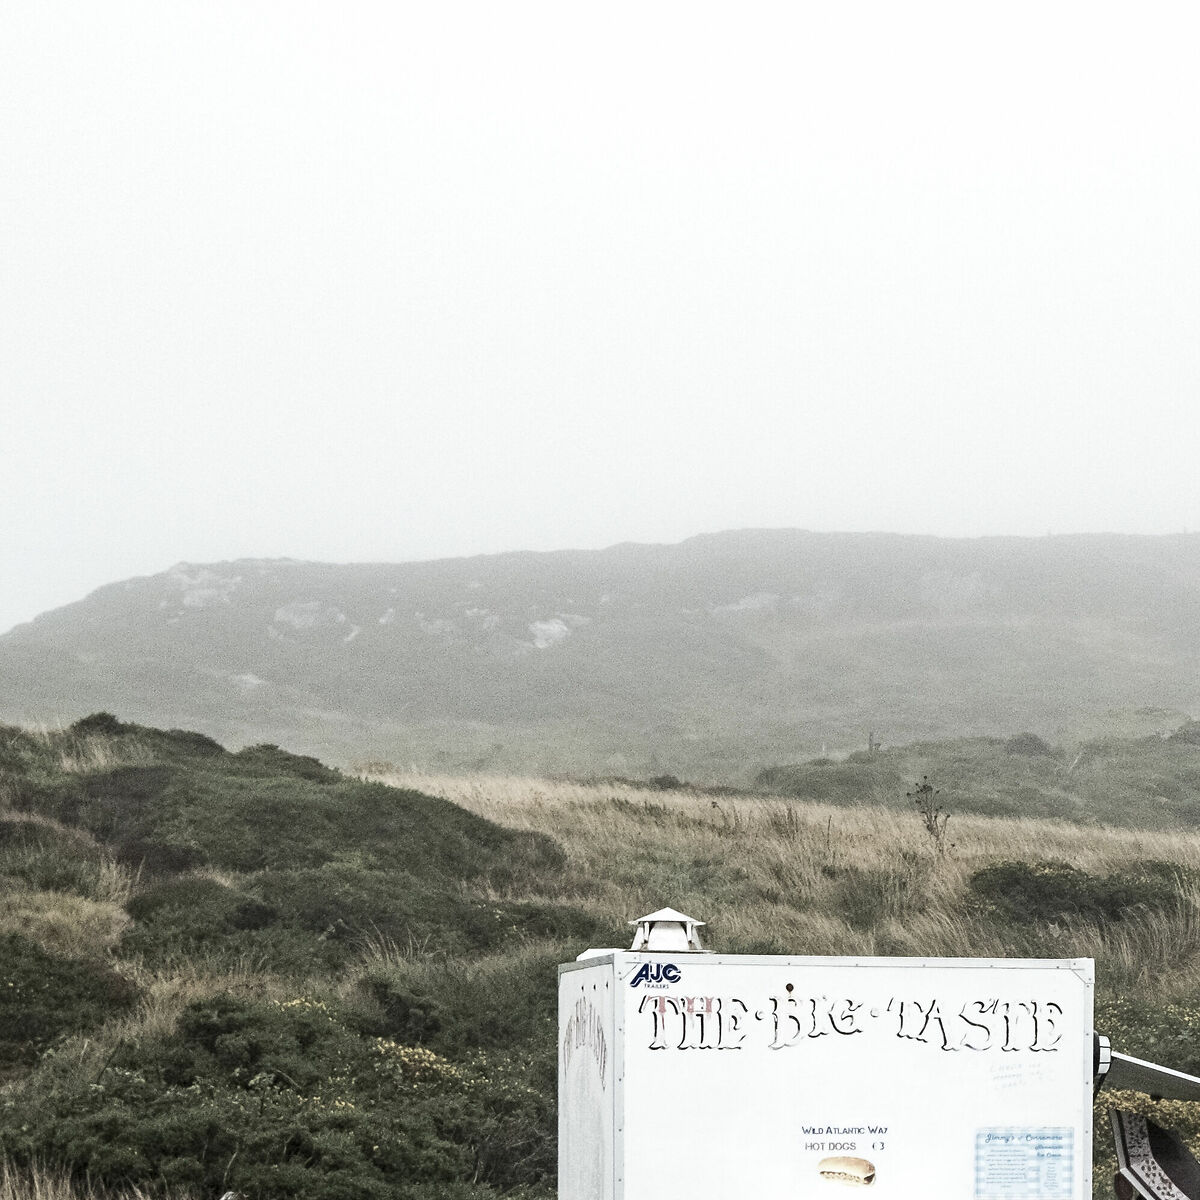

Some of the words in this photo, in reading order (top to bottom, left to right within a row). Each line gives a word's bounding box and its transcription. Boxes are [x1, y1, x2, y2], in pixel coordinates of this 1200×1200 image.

[630, 963, 681, 987] AJC
[639, 995, 748, 1050] THE
[768, 997, 863, 1050] BIG
[887, 997, 1063, 1052] TASTE
[805, 1142, 825, 1151] HOT
[828, 1142, 857, 1151] DOGS
